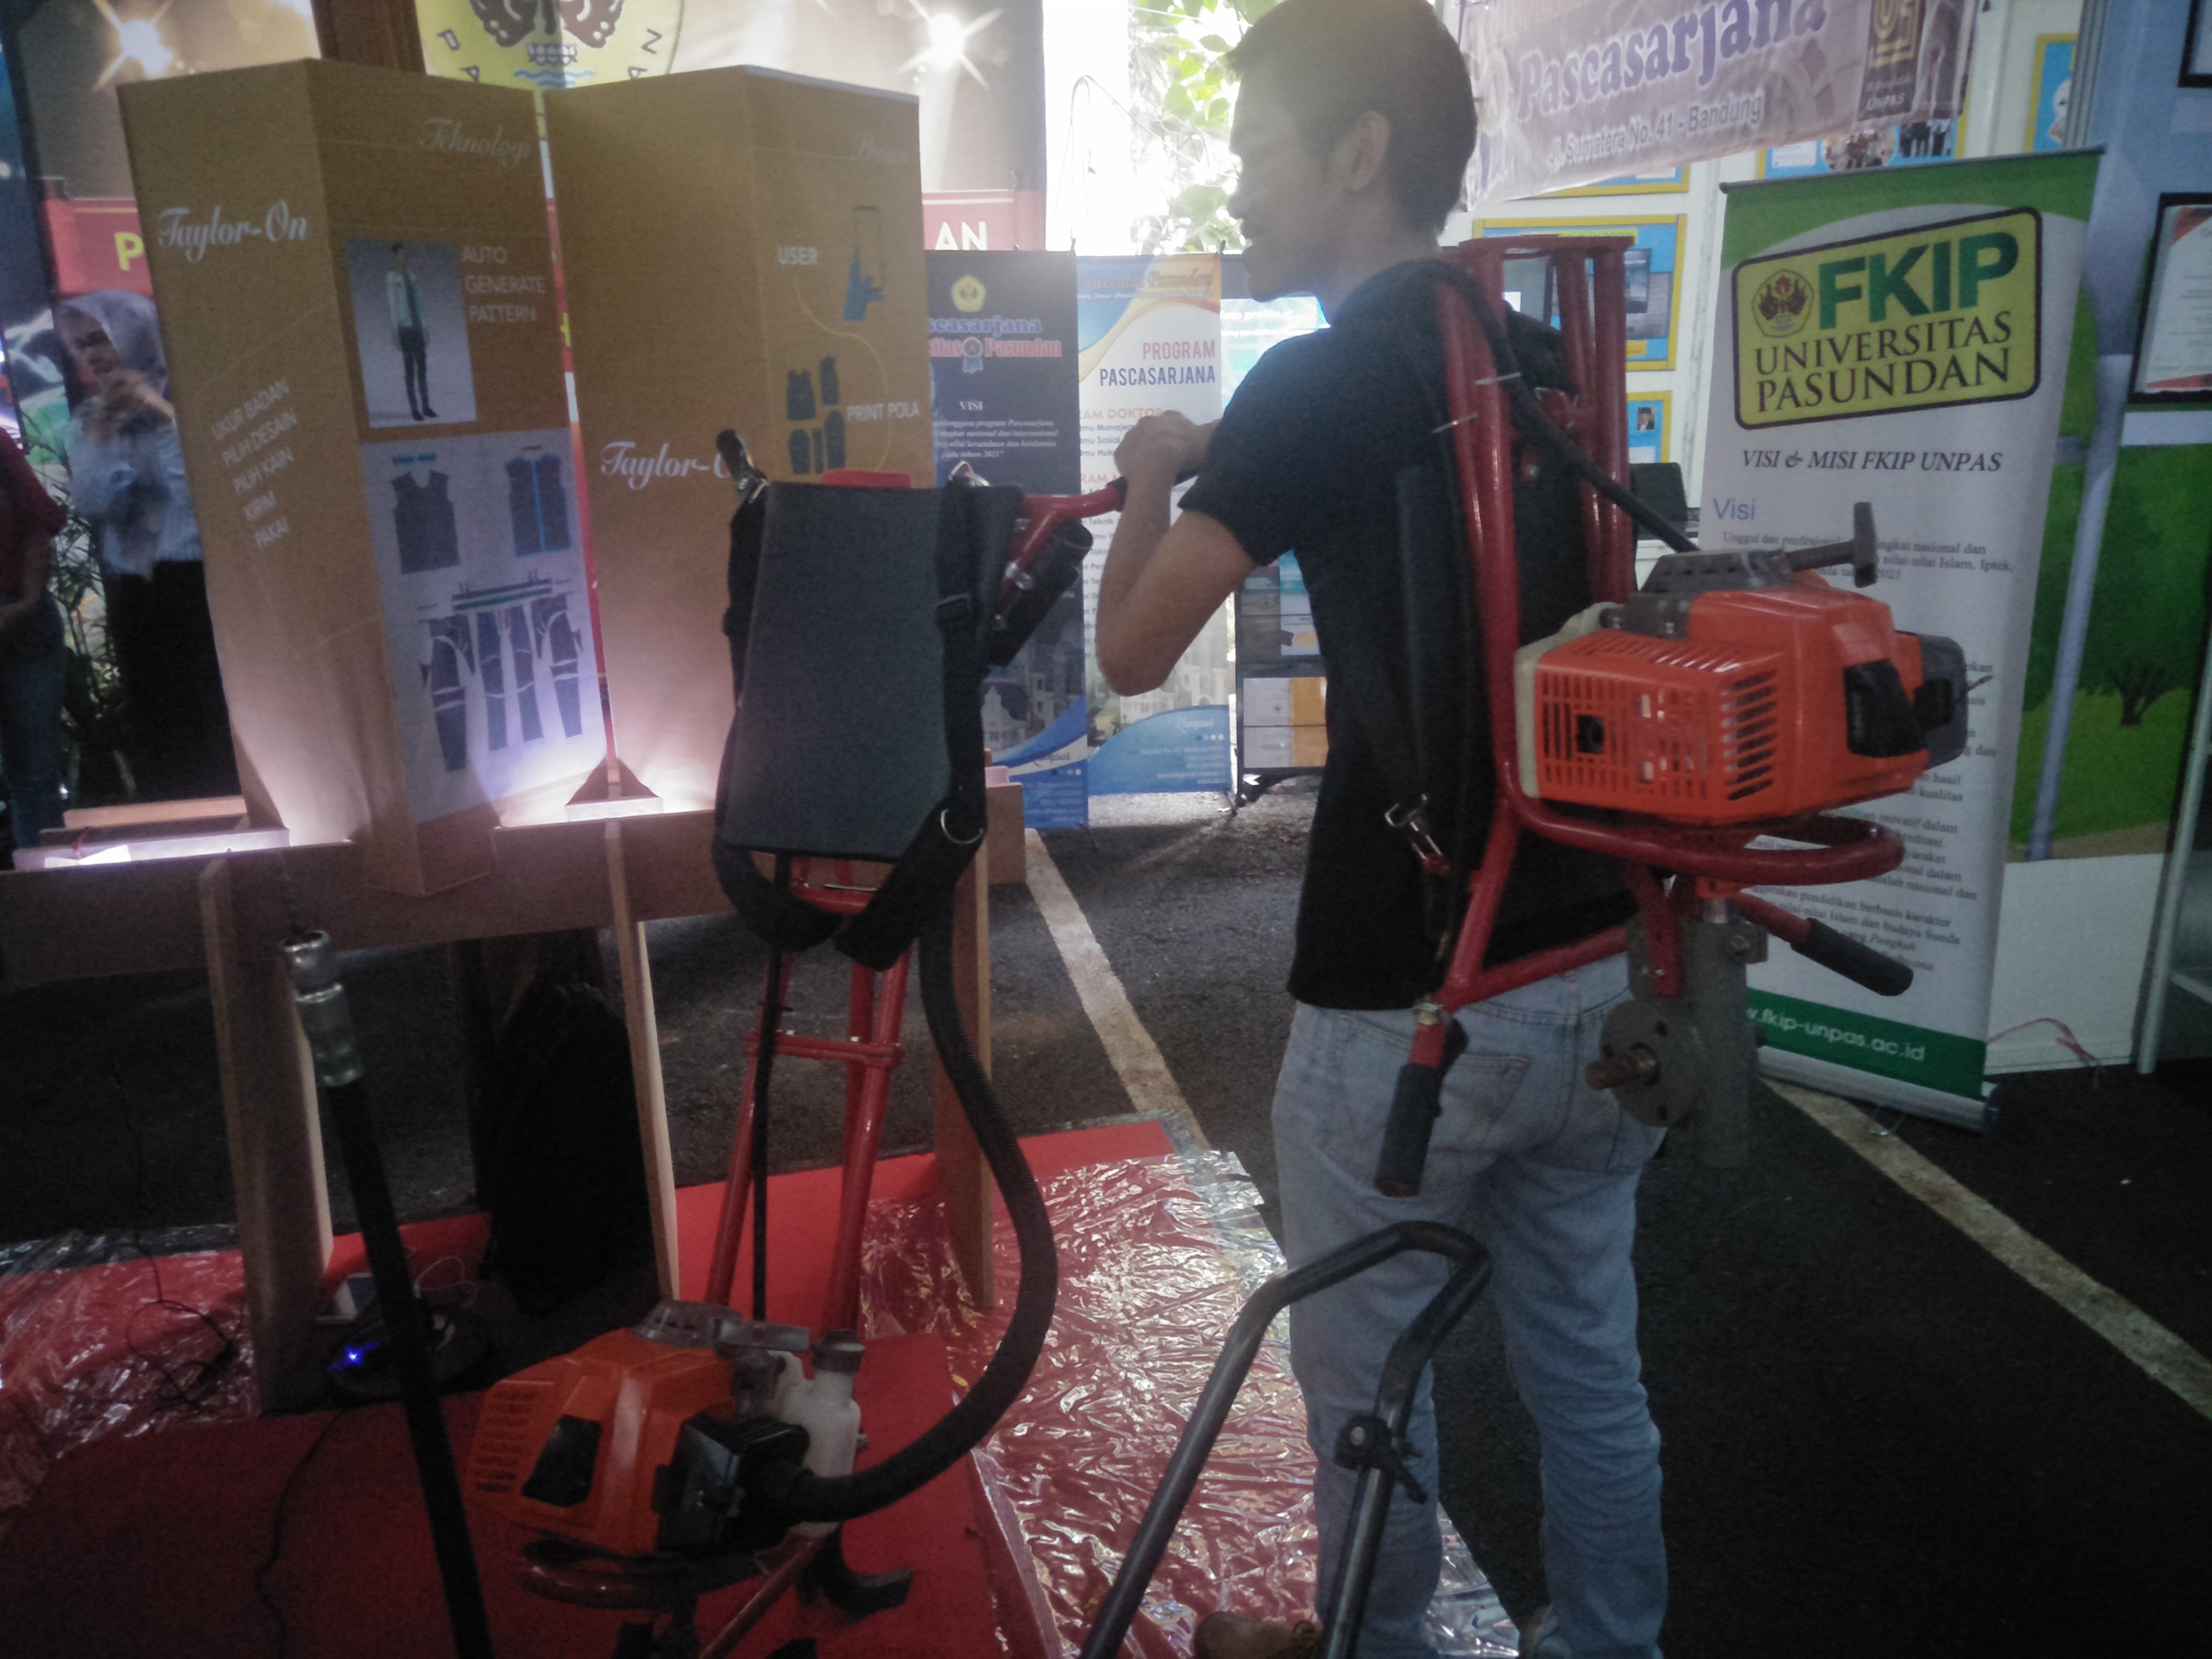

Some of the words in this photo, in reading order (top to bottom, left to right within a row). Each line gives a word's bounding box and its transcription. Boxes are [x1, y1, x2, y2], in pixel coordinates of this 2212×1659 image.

[1566, 131, 1626, 161] Sumatera
[1629, 120, 1652, 145] No.
[1656, 111, 1673, 138] 41
[1688, 95, 1762, 132] Bandung
[158, 200, 308, 262] Taylor-On
[462, 246, 507, 264] AUTO
[778, 246, 819, 265] USER
[464, 275, 546, 294] GENERATE
[1819, 232, 2018, 331] FKIP
[468, 304, 537, 322] PATTERN
[984, 337, 1062, 357] Pasundan
[1142, 340, 1216, 360] PROGRAM
[1755, 311, 2012, 376] UNIVERSITAS
[1100, 365, 1216, 387] PASCASARJANA
[1756, 348, 2010, 413] PASUNDAN
[244, 378, 290, 420] BADAN
[959, 401, 983, 411] VISI
[846, 404, 884, 422] PRINT
[887, 401, 921, 419] POLA
[1742, 450, 1781, 468] VISI
[1784, 454, 1803, 468] &
[1807, 450, 1858, 469] MISI
[1861, 451, 1916, 470] FKIP
[1920, 452, 2002, 472] UNPAS
[1713, 498, 1755, 521] Visi
[1723, 531, 1759, 546] Unggul
[1762, 533, 1779, 544] dan
[1913, 542, 1960, 554] nasional
[1964, 543, 1986, 555] dan
[1975, 744, 1997, 757] dan
[1933, 773, 1961, 786] hasil
[1919, 787, 1964, 802] kualitas
[1923, 819, 1958, 834] dalam
[1926, 867, 1962, 882] dalam
[1906, 882, 1953, 896] nasional
[1956, 887, 1978, 901] dan
[1905, 910, 1951, 928] karakter
[1861, 918, 1880, 929] dan
[1924, 929, 1960, 945] Sunda
[1747, 1007, 1927, 1062] w.fkip-unpas.ac.id
